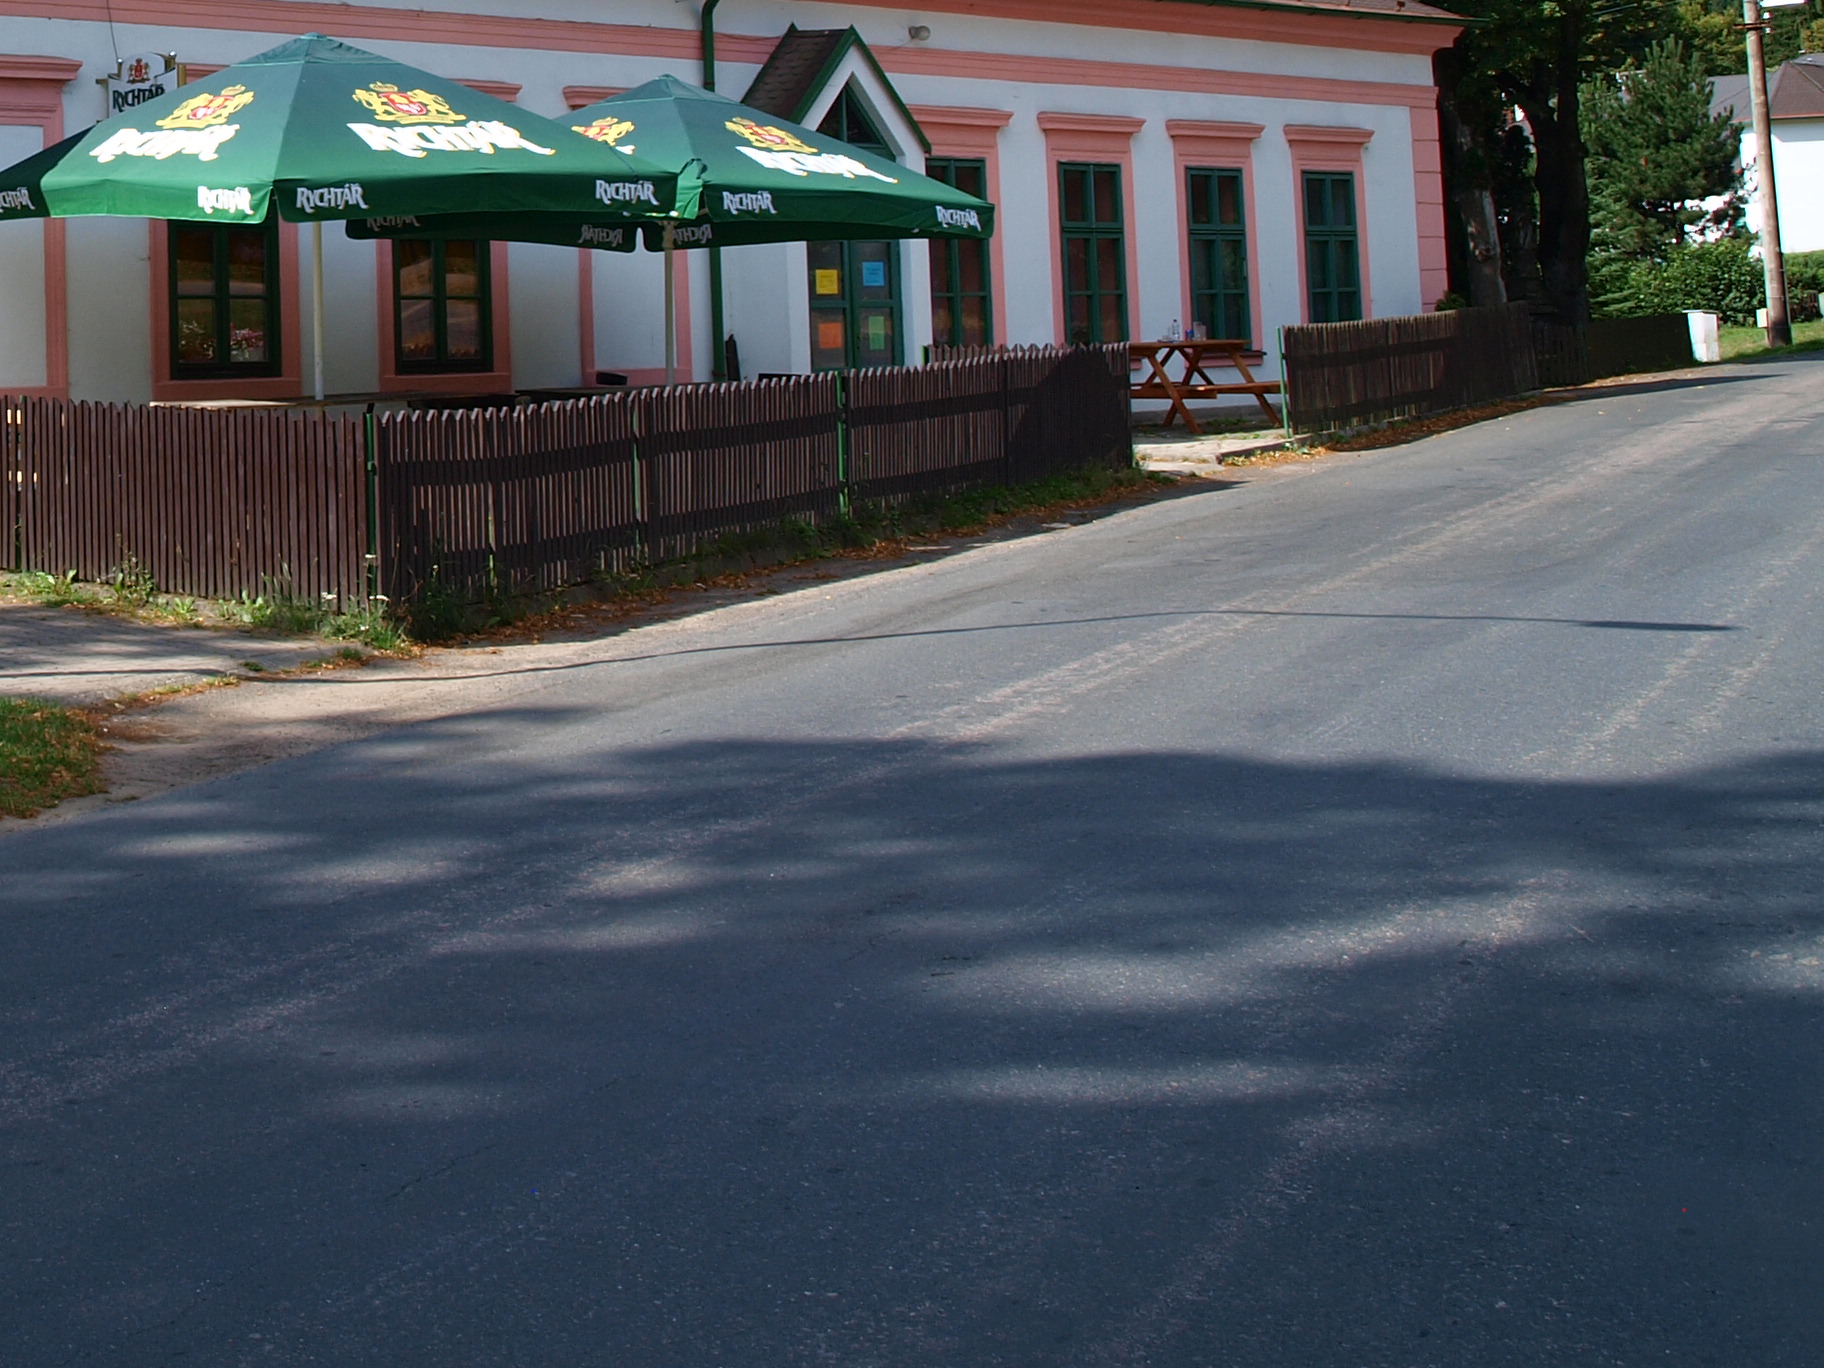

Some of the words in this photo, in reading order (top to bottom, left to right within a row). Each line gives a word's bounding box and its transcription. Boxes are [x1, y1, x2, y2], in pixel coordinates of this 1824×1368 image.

[296, 183, 369, 213] RYCHTÁŘ
[595, 180, 660, 205] RYCHTÁŘ
[722, 190, 778, 215] RYCHTÁŘ
